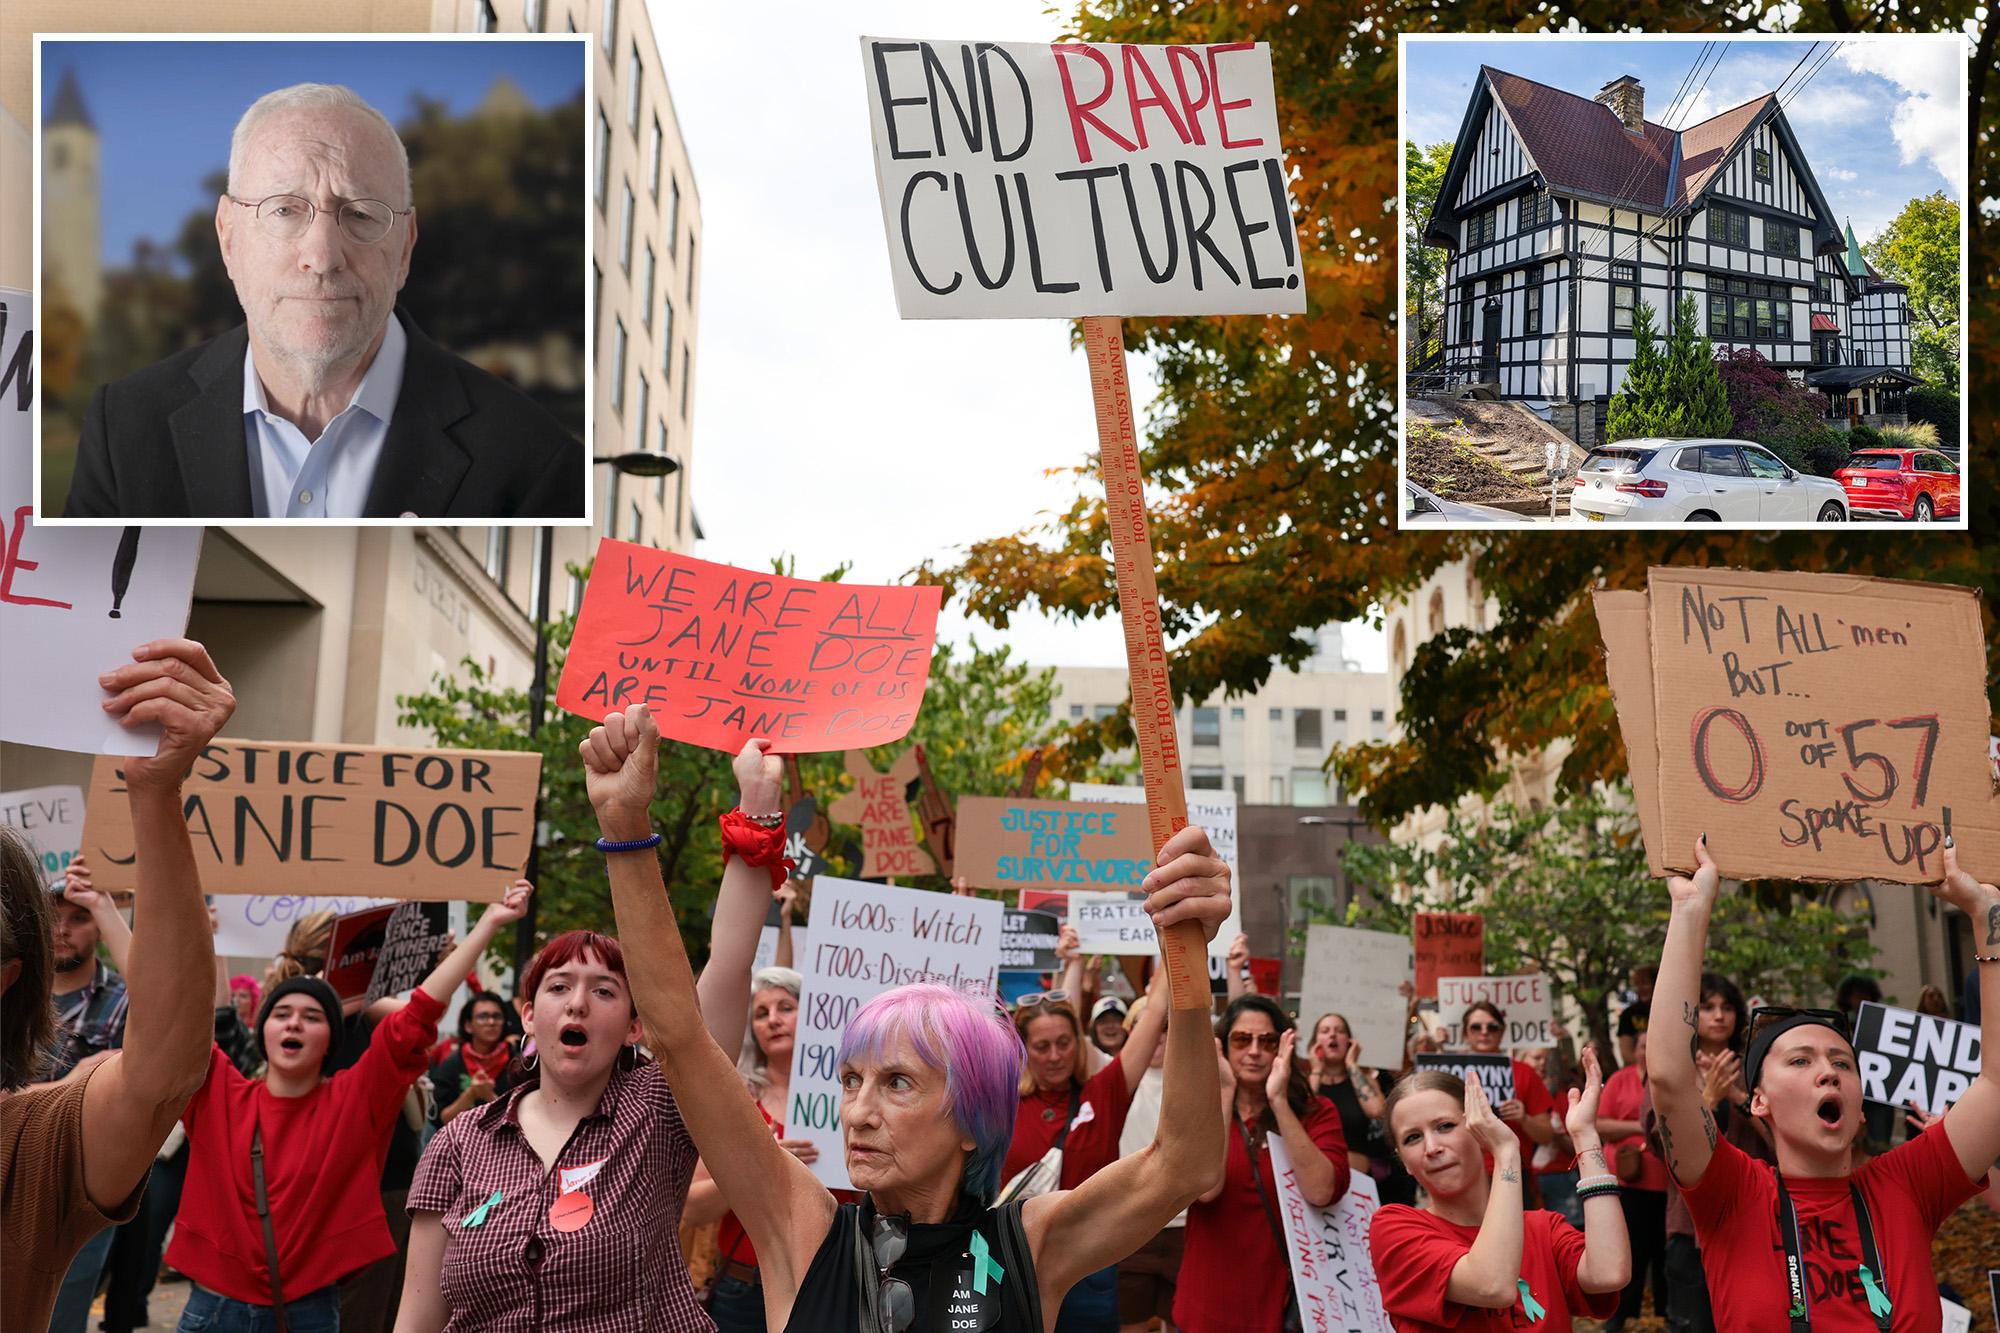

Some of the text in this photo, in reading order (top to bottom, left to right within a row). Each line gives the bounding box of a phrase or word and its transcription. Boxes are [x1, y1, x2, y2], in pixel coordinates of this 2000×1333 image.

[872, 42, 1264, 163] END RAPE
[900, 158, 1299, 295] CULTURE!
[1108, 336, 1145, 544] HOME OF THE FINEST PAINTS
[0, 505, 73, 610] E
[626, 554, 924, 636] WE ARE ALL
[617, 604, 924, 675] JANE DOE
[1775, 604, 1843, 655] ALL
[619, 652, 907, 699] UNTIL NONE OF US
[1141, 598, 1177, 772] THE HOME DEPOT
[582, 671, 911, 738] ARE JANE DOE
[1785, 719, 1831, 739] OUT
[383, 753, 494, 793] FOR
[1800, 742, 1837, 769] OF
[1835, 713, 1941, 809] 57
[860, 776, 897, 799] WE
[860, 802, 905, 824] ARE
[999, 807, 1117, 836] JUSTICE
[374, 801, 524, 871] DOE
[864, 827, 912, 848] JANE
[1030, 832, 1082, 858] FOR
[876, 852, 921, 874] DOE
[996, 855, 1151, 885] SURVIVORS
[912, 907, 982, 945] Witch
[389, 954, 430, 977] HOUR
[390, 972, 420, 995] DAY
[1443, 979, 1543, 1006] JUSTICE
[1511, 1020, 1549, 1043] DOE
[1878, 1008, 1981, 1073] END
[800, 1044, 842, 1084] 190
[1858, 1050, 1976, 1115] RAP
[952, 1290, 970, 1299] AM
[1788, 1255, 1801, 1303] LYMPUS
[948, 1304, 979, 1314] JANE
[952, 1319, 977, 1329] DOE
